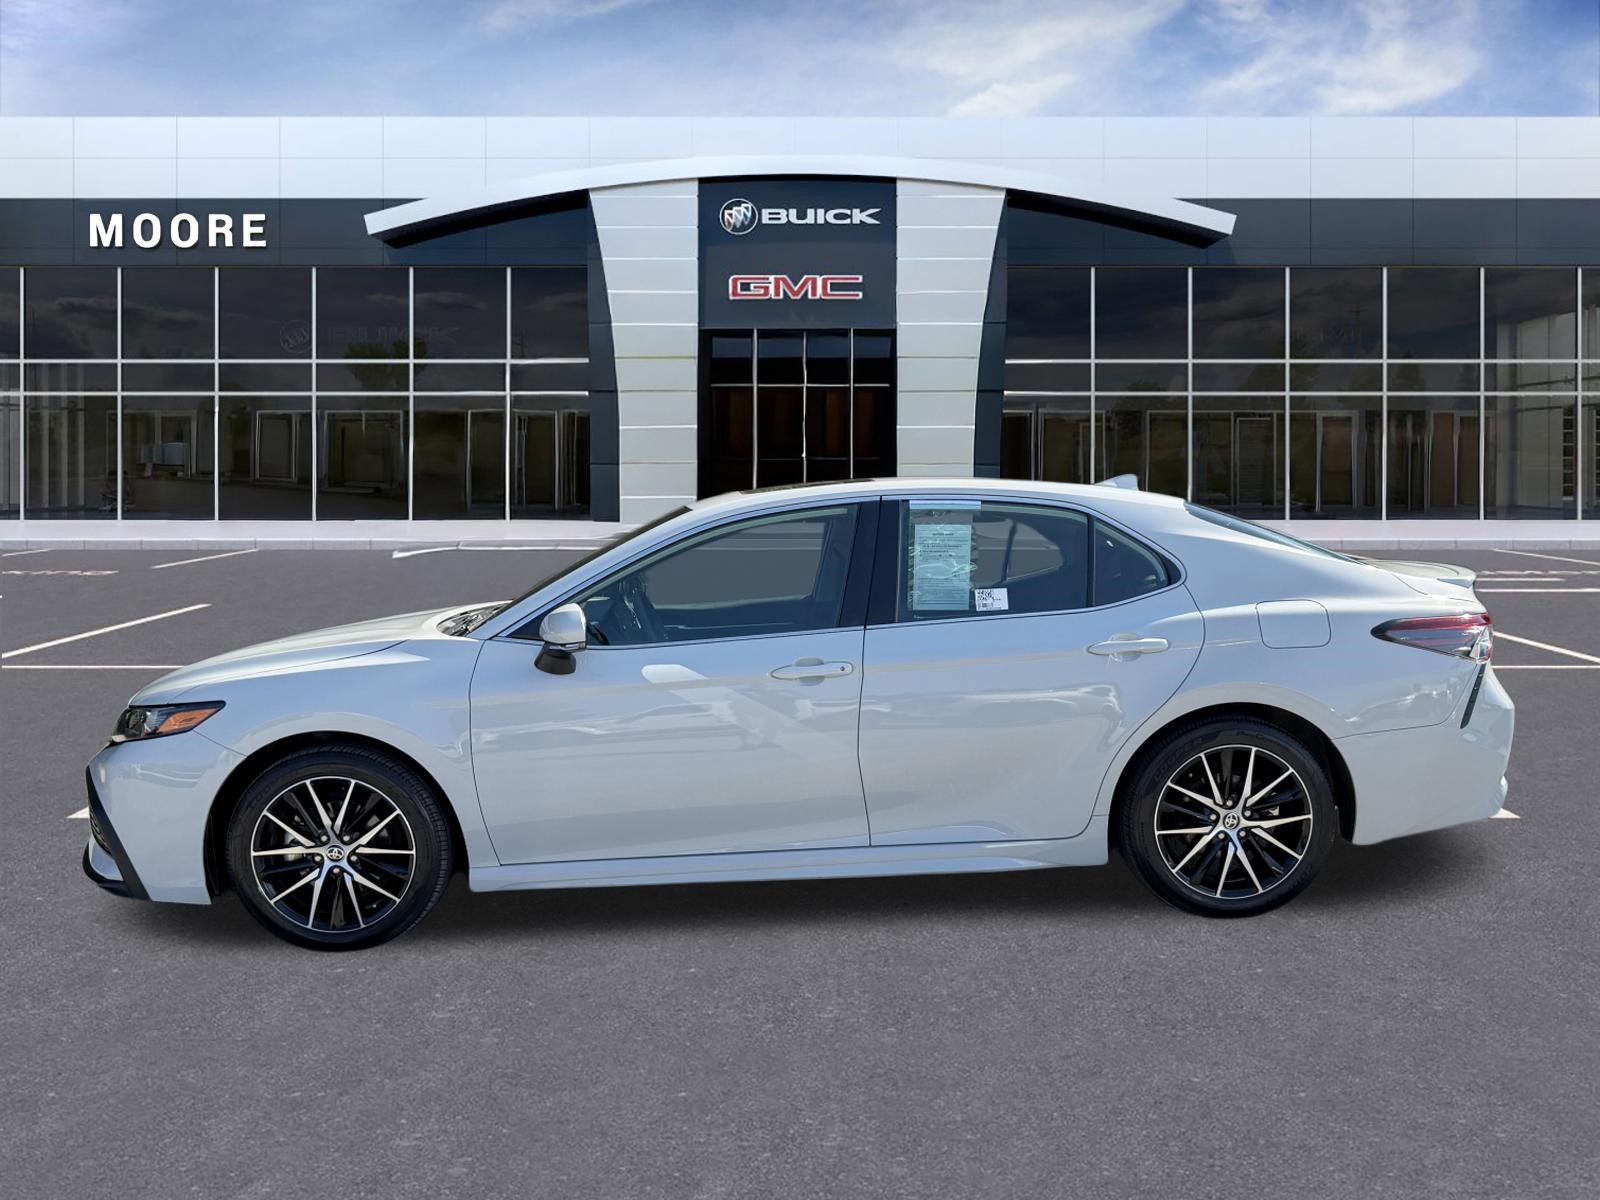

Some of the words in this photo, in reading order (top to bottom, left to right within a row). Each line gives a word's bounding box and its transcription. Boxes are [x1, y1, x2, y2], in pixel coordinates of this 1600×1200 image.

[762, 208, 881, 224] BUICK
[90, 213, 266, 248] MOORE
[729, 275, 863, 300] GMC
